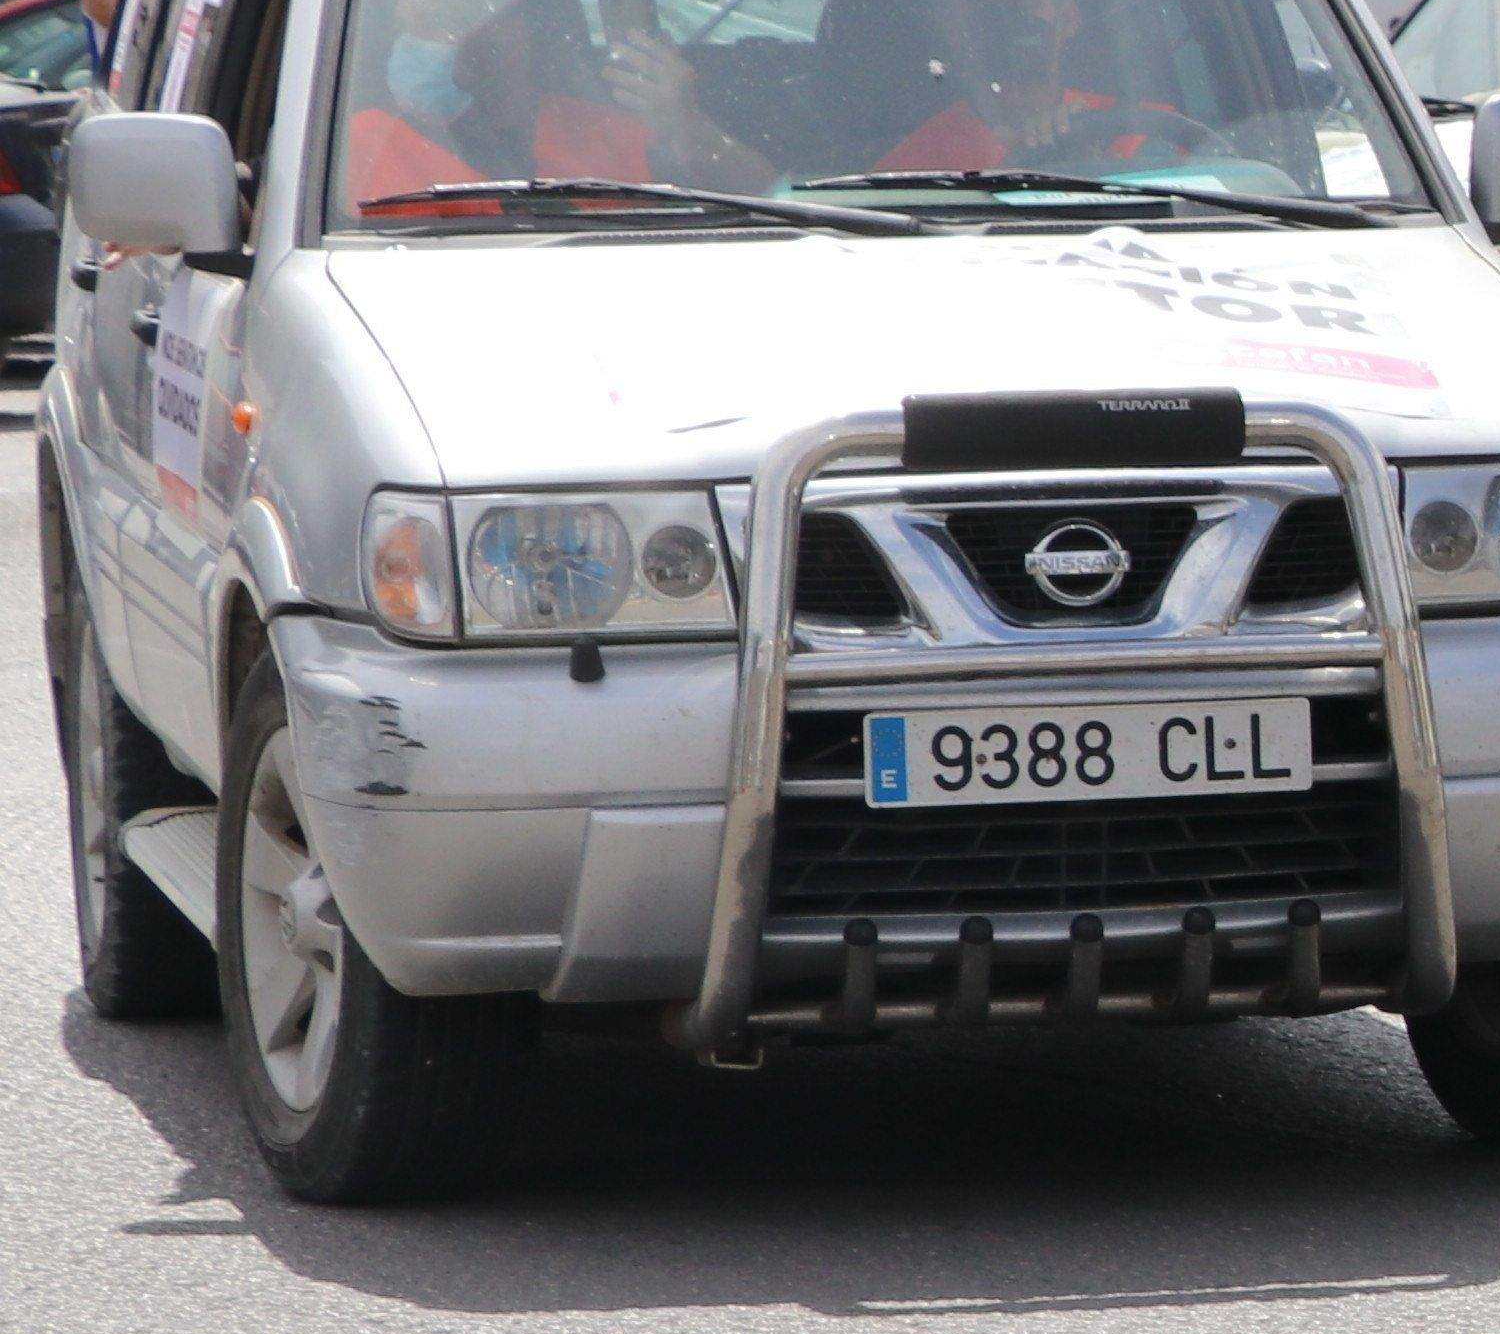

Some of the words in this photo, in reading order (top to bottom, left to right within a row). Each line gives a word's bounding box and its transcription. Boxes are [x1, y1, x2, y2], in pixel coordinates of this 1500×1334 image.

[1036, 553, 1121, 572] NISSAN
[930, 718, 1115, 792] 9388
[1157, 712, 1292, 782] CLL
[880, 768, 898, 789] E
